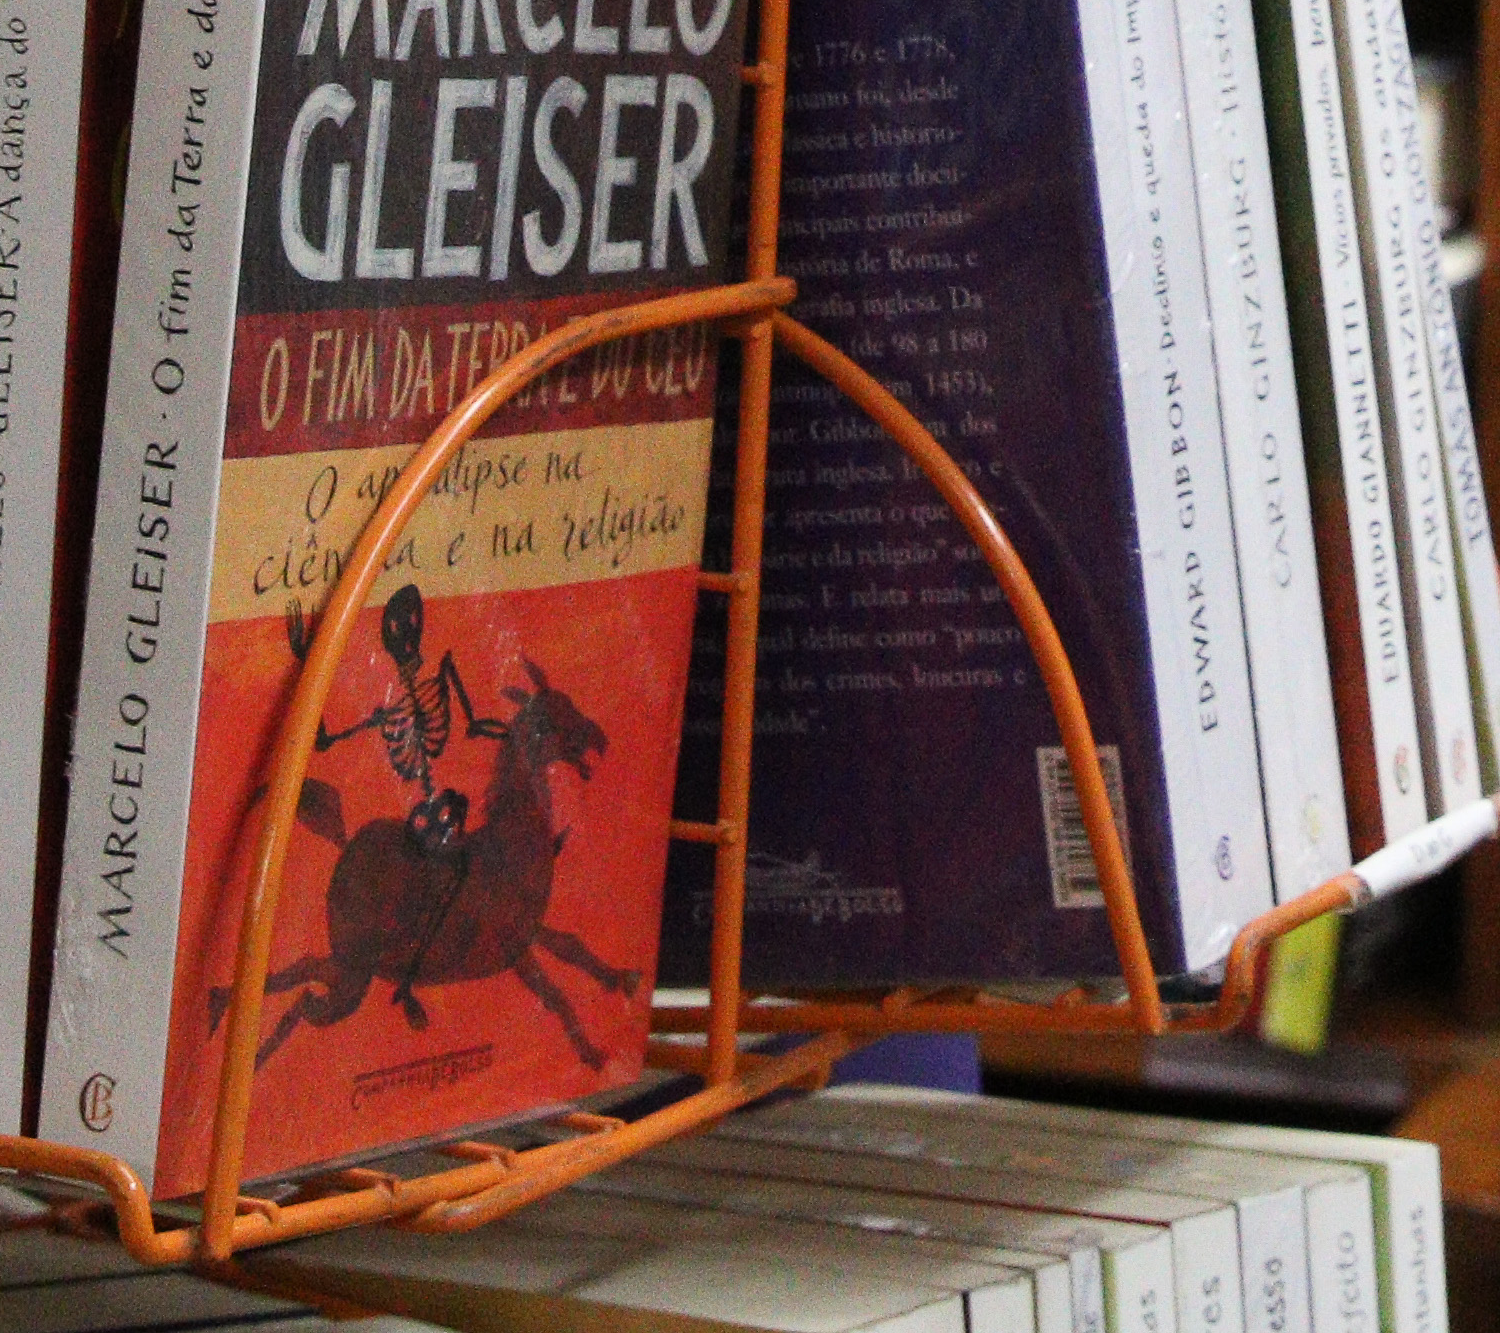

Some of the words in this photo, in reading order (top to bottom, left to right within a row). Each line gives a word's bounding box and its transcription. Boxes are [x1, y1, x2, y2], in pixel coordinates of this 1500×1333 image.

[2, 15, 27, 59] do
[195, 41, 217, 66] e
[172, 84, 210, 191] Terra
[278, 72, 716, 283] GLEISER
[169, 202, 199, 251] da
[1229, 156, 1273, 403] GINZBURG
[151, 358, 185, 396] O
[160, 275, 194, 346] fim
[259, 336, 291, 433] O
[302, 326, 375, 428] FIM
[389, 325, 435, 419] DA
[1342, 282, 1381, 504] GIANNETTI
[303, 463, 339, 525] O
[356, 445, 528, 514] apalipse
[543, 447, 588, 482] na
[1164, 368, 1198, 531] GIBBON
[1258, 431, 1292, 592] CARLO
[127, 438, 178, 665] GLEISER
[252, 529, 421, 597] ciênia
[445, 531, 467, 567] e
[491, 517, 537, 557] na
[561, 487, 688, 569] religião
[1375, 518, 1398, 684] EDUARDO
[1186, 548, 1220, 734] EDWARD
[98, 692, 149, 960] MARCELO
